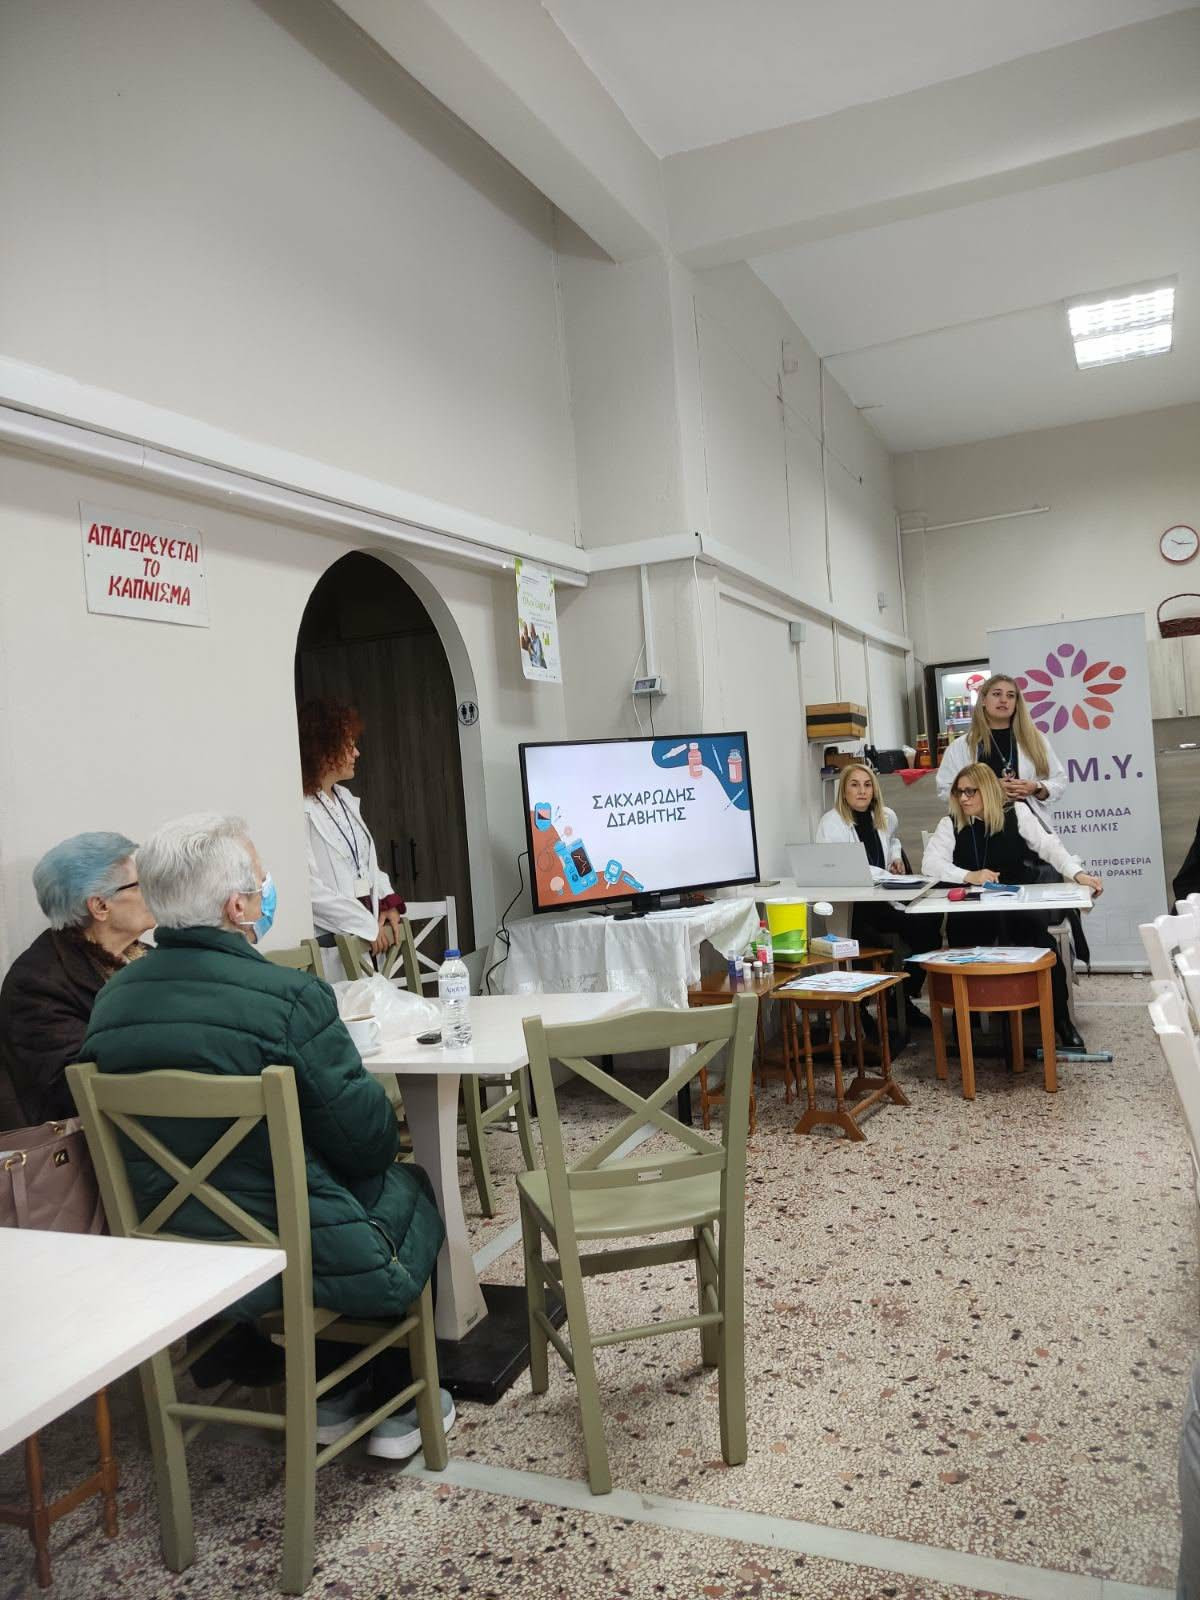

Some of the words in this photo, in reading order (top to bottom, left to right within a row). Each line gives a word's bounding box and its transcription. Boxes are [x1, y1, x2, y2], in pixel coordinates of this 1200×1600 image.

[143, 557, 161, 577] ΤΟ
[108, 575, 191, 606] ΚΑΠΝΙΣΜΑ
[592, 787, 696, 809] ΣΑΚΧΑΡΩΔΗΣ
[607, 807, 687, 828] ΔΙΑΒΗΤΗΣ
[1085, 807, 1132, 818] ΟΜΑΔΑ
[1081, 822, 1119, 833] ΚΙΛΚΙΣ
[1106, 869, 1144, 877] ΘΡΑΚΗΣ
